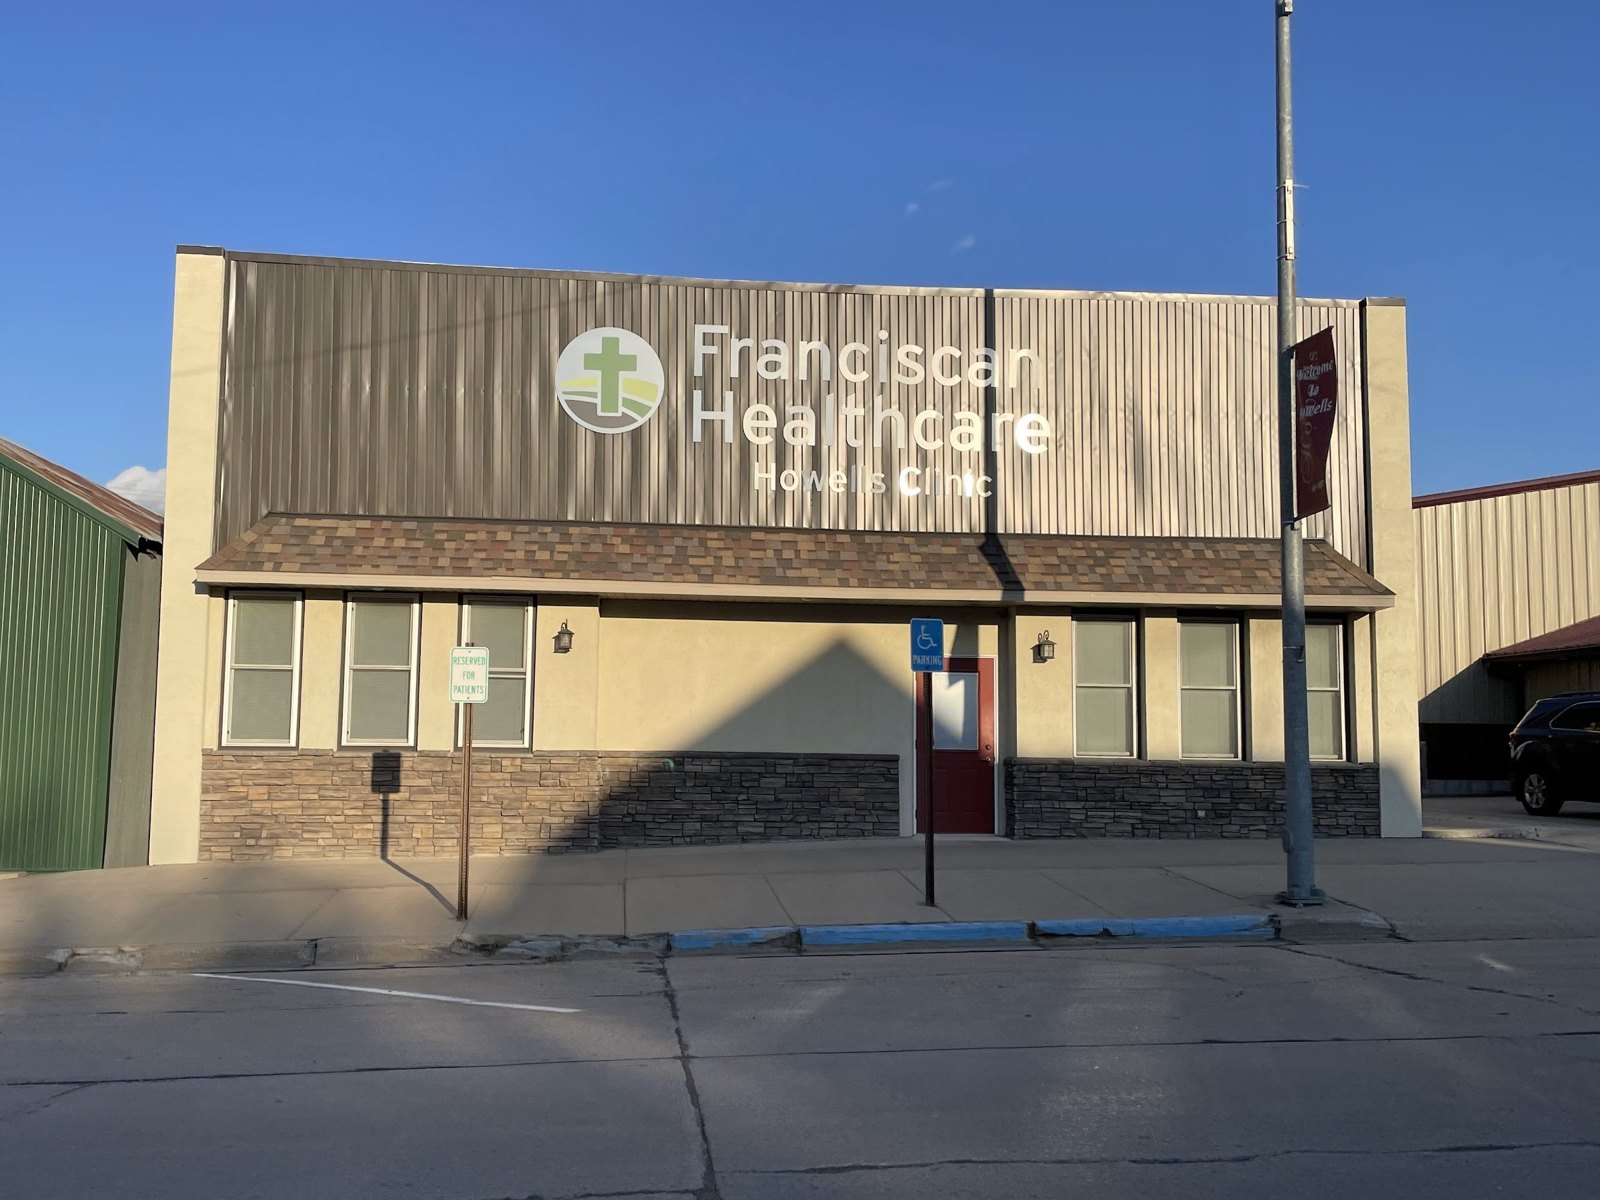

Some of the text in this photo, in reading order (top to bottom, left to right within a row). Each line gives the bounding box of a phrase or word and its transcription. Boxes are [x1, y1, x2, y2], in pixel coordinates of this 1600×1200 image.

[694, 324, 1039, 389] Franciscan
[692, 389, 1051, 454] Healthcare
[753, 461, 993, 498] Howells Clinic
[453, 656, 486, 665] RESERVED
[913, 655, 942, 665] PARKING
[463, 671, 475, 680] FOR
[453, 685, 484, 694] PATIENTS
